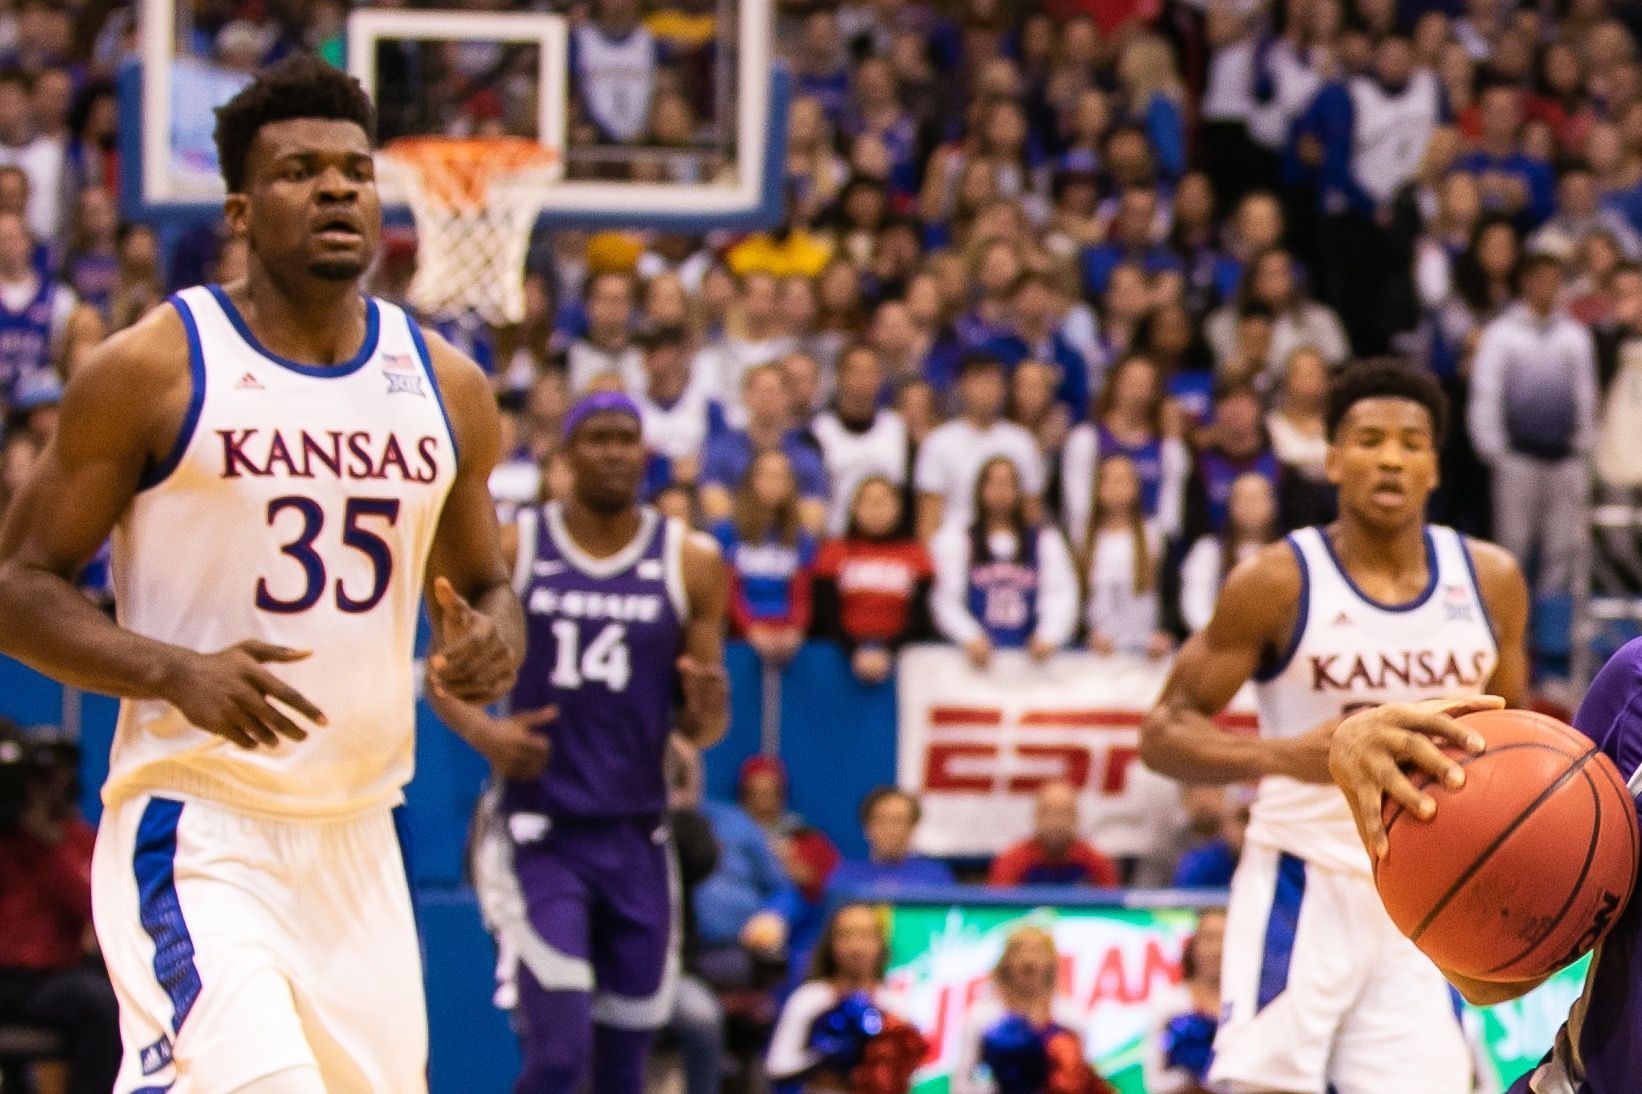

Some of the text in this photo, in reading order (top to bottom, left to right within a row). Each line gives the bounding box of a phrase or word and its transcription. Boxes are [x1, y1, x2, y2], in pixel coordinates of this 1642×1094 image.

[216, 428, 440, 484] KANSAS
[254, 494, 401, 614] 35
[550, 618, 631, 693] 14
[1310, 649, 1487, 691] KANSAS
